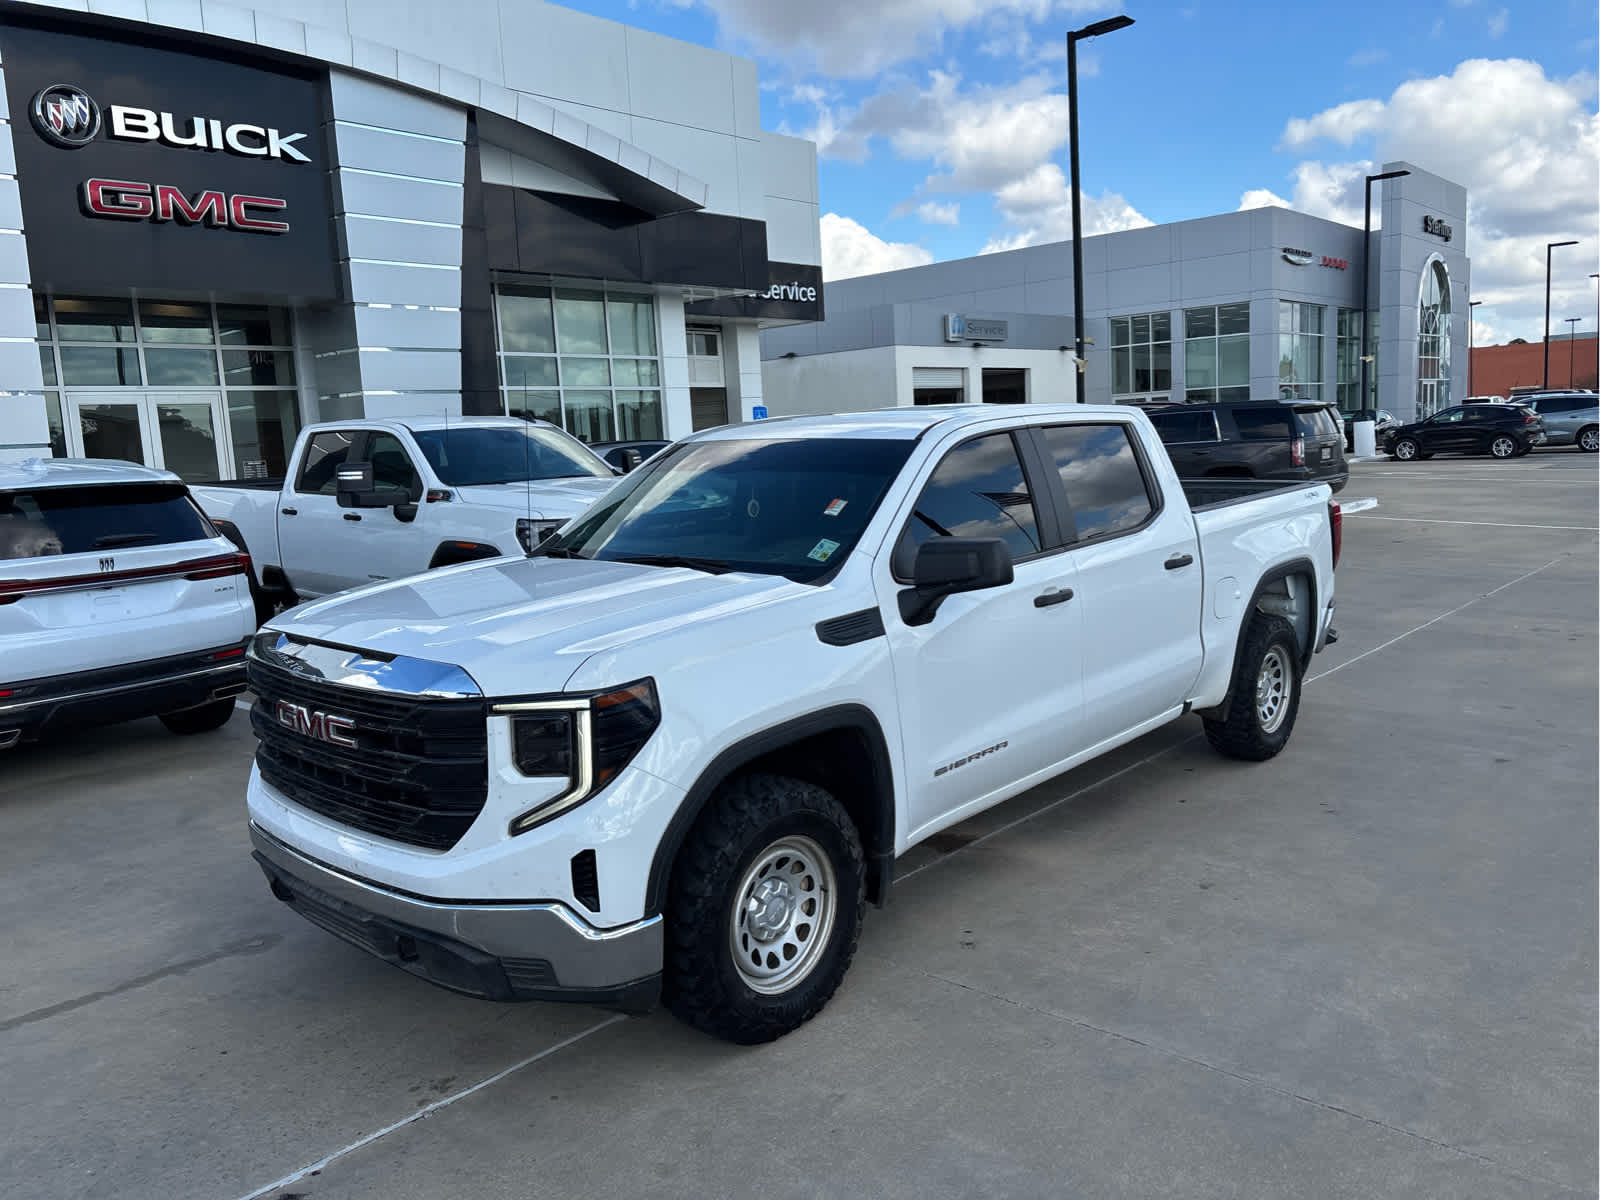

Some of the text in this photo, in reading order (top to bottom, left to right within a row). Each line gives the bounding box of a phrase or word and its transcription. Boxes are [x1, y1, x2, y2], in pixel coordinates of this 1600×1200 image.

[110, 104, 312, 162] BUICK
[86, 178, 289, 232] GMC
[967, 322, 1004, 336] Service
[275, 699, 359, 749] GMC
[934, 740, 1009, 776] SIERRA
